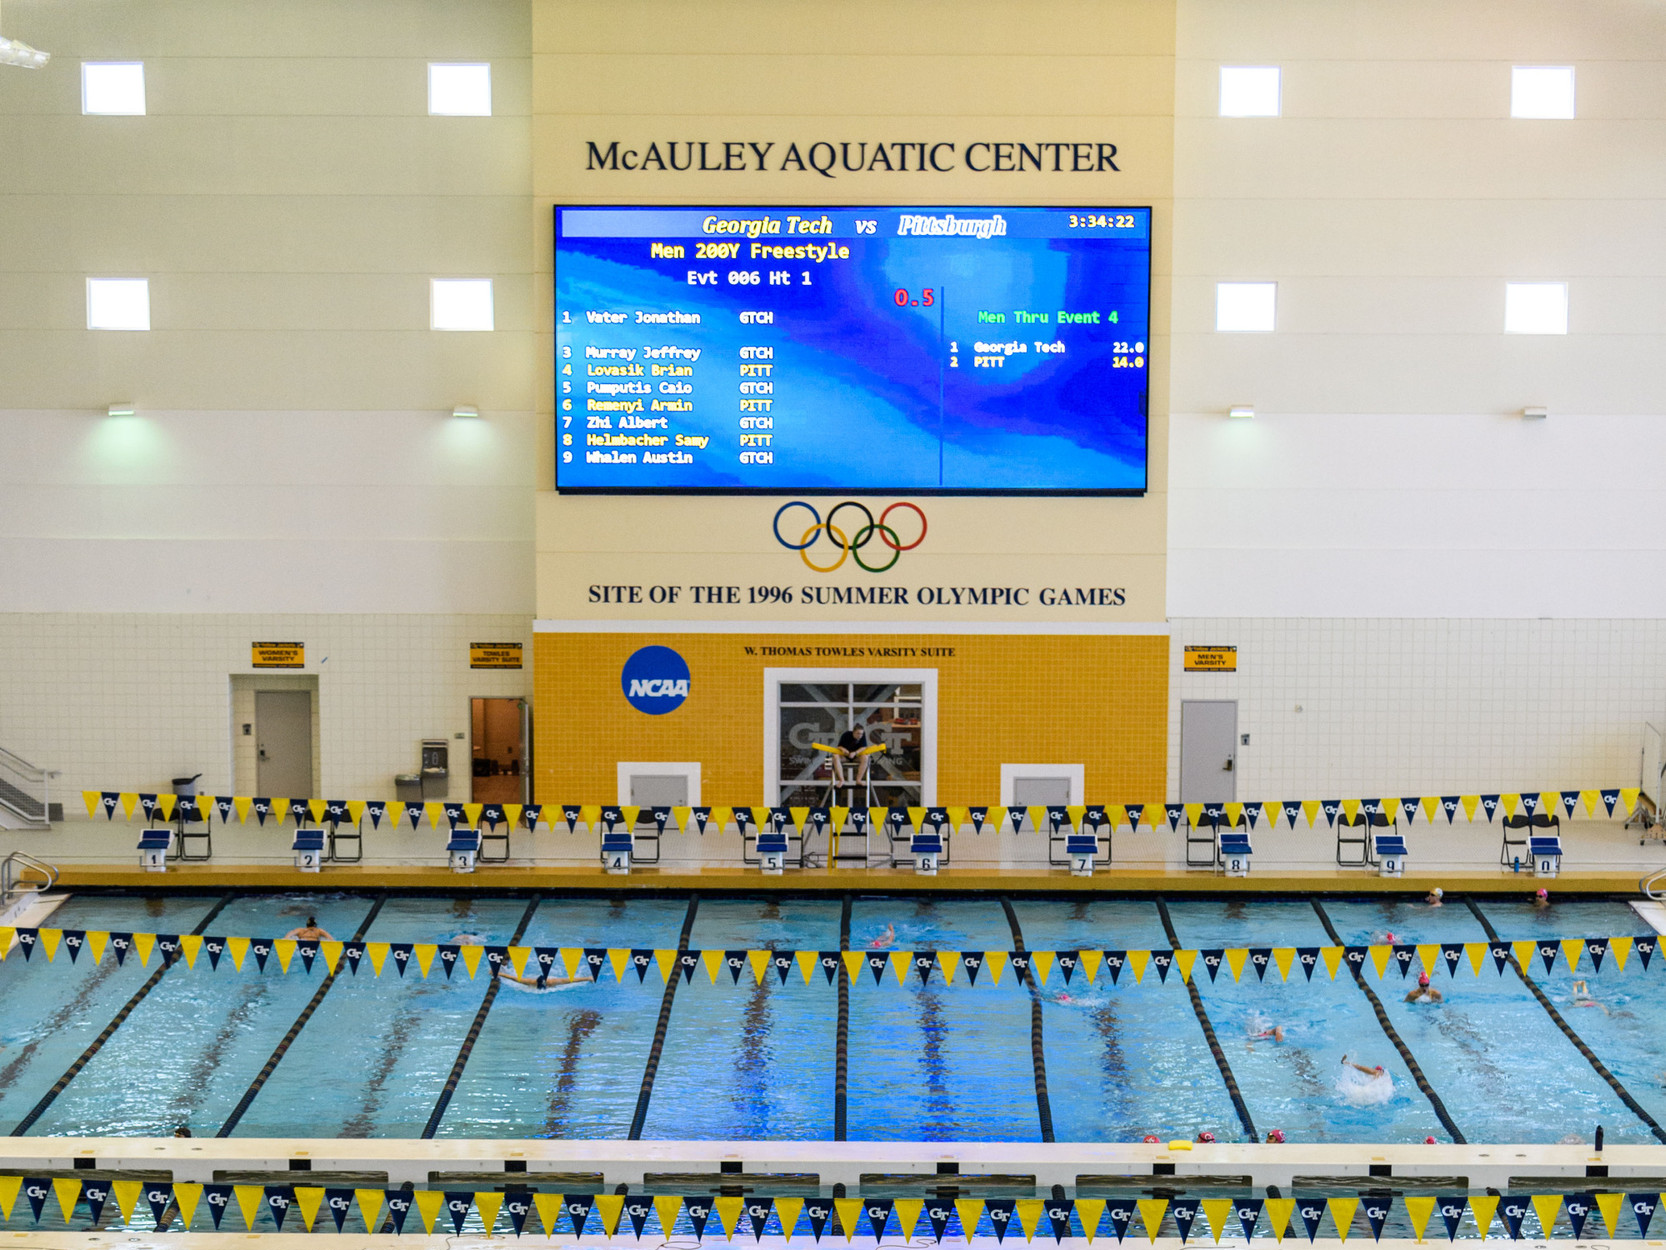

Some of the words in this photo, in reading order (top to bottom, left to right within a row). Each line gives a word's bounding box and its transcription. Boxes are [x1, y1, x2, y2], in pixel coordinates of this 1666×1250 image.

[585, 141, 775, 171] McAULEY
[779, 142, 955, 178] AQUATIC
[965, 142, 1121, 172] CENTER
[702, 215, 780, 238] Georgia
[786, 215, 833, 234] Tech
[855, 219, 878, 234] vs
[898, 214, 1007, 239] Pittsburgh
[1069, 215, 1135, 228] 3:34:22
[650, 243, 685, 258] Men
[695, 243, 741, 258] 200Y
[750, 242, 850, 262] Freestyle
[687, 271, 718, 285] Evt
[728, 271, 761, 285] 006
[769, 271, 791, 285] Ht
[801, 271, 812, 285] 1
[894, 288, 934, 306] 0.5
[562, 311, 572, 324] 1
[635, 311, 701, 324] Jonathan
[739, 311, 773, 324] GTCH
[978, 310, 1005, 324] Men
[1013, 310, 1048, 324] Thru
[1057, 310, 1100, 324] Event
[1108, 310, 1119, 324] 4
[562, 346, 572, 360] 3
[585, 346, 637, 362] Murray
[643, 346, 702, 362] Jeffrey
[739, 346, 773, 360] GTCH
[950, 341, 958, 353] 1
[973, 341, 1027, 355] Georgia
[1034, 341, 1065, 353] Tech
[1113, 341, 1145, 353] 22.0
[950, 356, 958, 368] 2
[974, 356, 1005, 368] PITT
[1112, 356, 1144, 368] 14.0
[562, 364, 572, 376] 4
[587, 364, 644, 376] Lovasik
[651, 364, 693, 376] Brian
[739, 364, 773, 376] PITT
[562, 382, 572, 394] 5
[659, 382, 693, 394] Caio
[739, 382, 773, 394] GTCH
[562, 399, 572, 412] 6
[650, 399, 693, 412] Armin
[739, 399, 773, 412] PITT
[562, 416, 572, 429] 7
[587, 416, 612, 429] Zhi
[618, 416, 668, 429] Albert
[739, 416, 773, 429] GTCH
[562, 434, 572, 446] 8
[675, 434, 710, 449] Samy
[739, 434, 773, 446] PITT
[562, 452, 572, 464] 9
[586, 452, 637, 464] Whalen
[643, 452, 693, 464] Austin
[739, 452, 773, 464] GTCH
[588, 584, 643, 604] SITE
[649, 585, 681, 604] OF
[690, 585, 741, 604] THE
[748, 585, 793, 604] 1996
[801, 586, 909, 605] SUMMER
[917, 587, 1030, 606] OLYMPIC
[1039, 587, 1126, 606] GAMES
[744, 646, 758, 657] W.
[760, 646, 813, 657] THOMAS
[814, 647, 866, 658] TOWLES
[868, 647, 919, 658] VARSITY
[920, 647, 956, 658] SUITE
[628, 679, 689, 697] NCAA
[151, 855, 157, 867] 1
[304, 855, 313, 868] 2
[459, 856, 467, 867] 3
[613, 857, 621, 868] 4
[768, 858, 776, 869] 5
[922, 858, 931, 871] 6
[1078, 859, 1087, 872] 7
[1231, 860, 1240, 872] 8
[1386, 861, 1395, 873] 9
[26, 1185, 47, 1199] GT
[86, 1188, 107, 1202] GT
[207, 1192, 228, 1206] GT
[268, 1195, 289, 1209] GT
[329, 1196, 350, 1210] GT
[388, 1198, 409, 1212] GT
[448, 1200, 469, 1214] GT
[508, 1201, 529, 1215] GT
[1633, 1202, 1654, 1216] GT
[568, 1203, 589, 1217] GT
[628, 1204, 649, 1218] GT
[688, 1205, 709, 1219] GT
[748, 1204, 769, 1218] GT
[808, 1205, 829, 1219] GT
[868, 1206, 889, 1220] GT
[929, 1207, 950, 1221] GT
[990, 1208, 1011, 1222] GT
[1048, 1207, 1069, 1221] GT
[1110, 1208, 1131, 1222] GT
[1173, 1207, 1194, 1221] GT
[1237, 1207, 1258, 1221] GT
[1301, 1206, 1322, 1220] GT
[1366, 1206, 1387, 1220] GT
[1504, 1205, 1525, 1219] GT
[1567, 1203, 1588, 1217] GT
